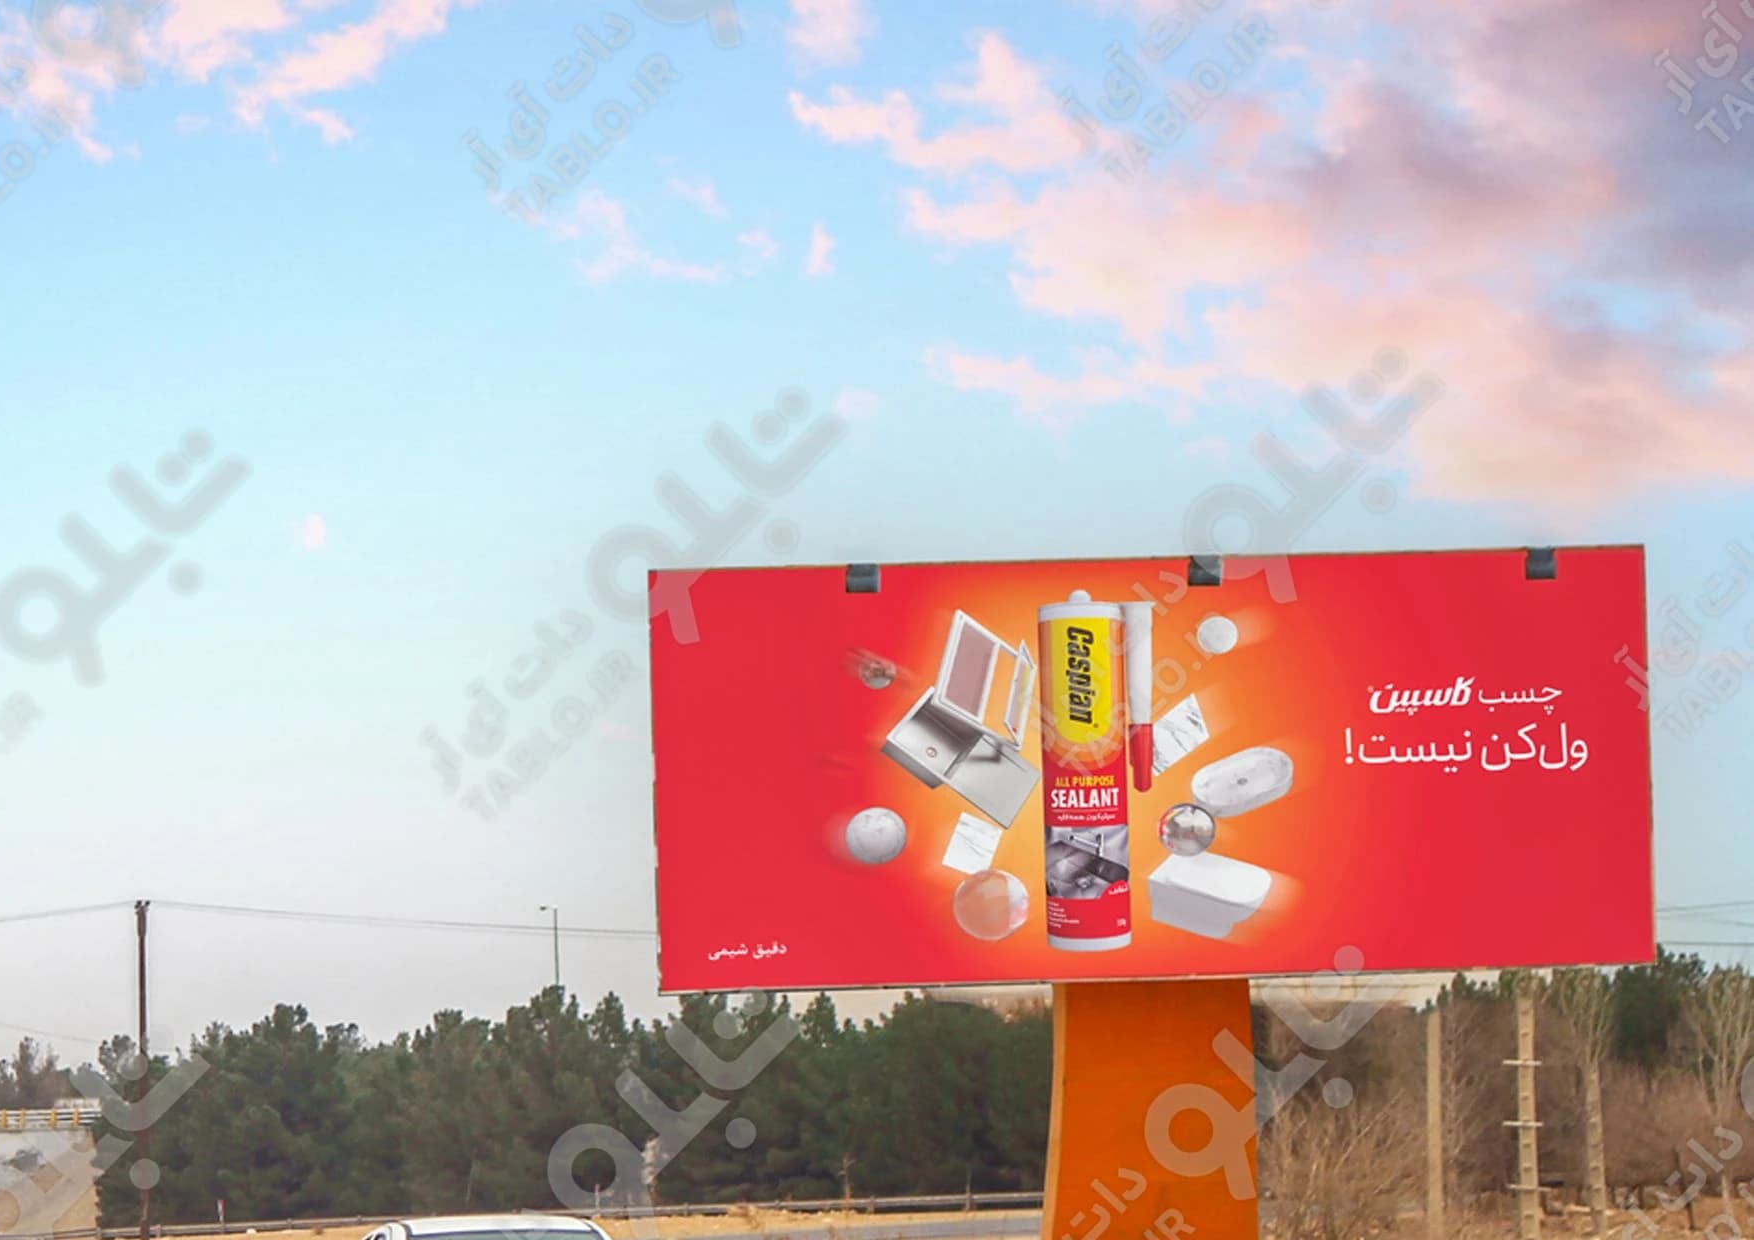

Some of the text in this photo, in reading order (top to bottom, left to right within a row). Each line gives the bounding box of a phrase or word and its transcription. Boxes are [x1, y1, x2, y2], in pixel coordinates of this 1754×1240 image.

[1066, 626, 1095, 725] Caspian
[1367, 676, 1562, 715] چسب کاسپین
[1344, 726, 1473, 773] نیست!
[1055, 775, 1115, 787] ALL PURPOSE
[1050, 787, 1119, 808] SEALANT
[708, 943, 748, 961] شیمی
